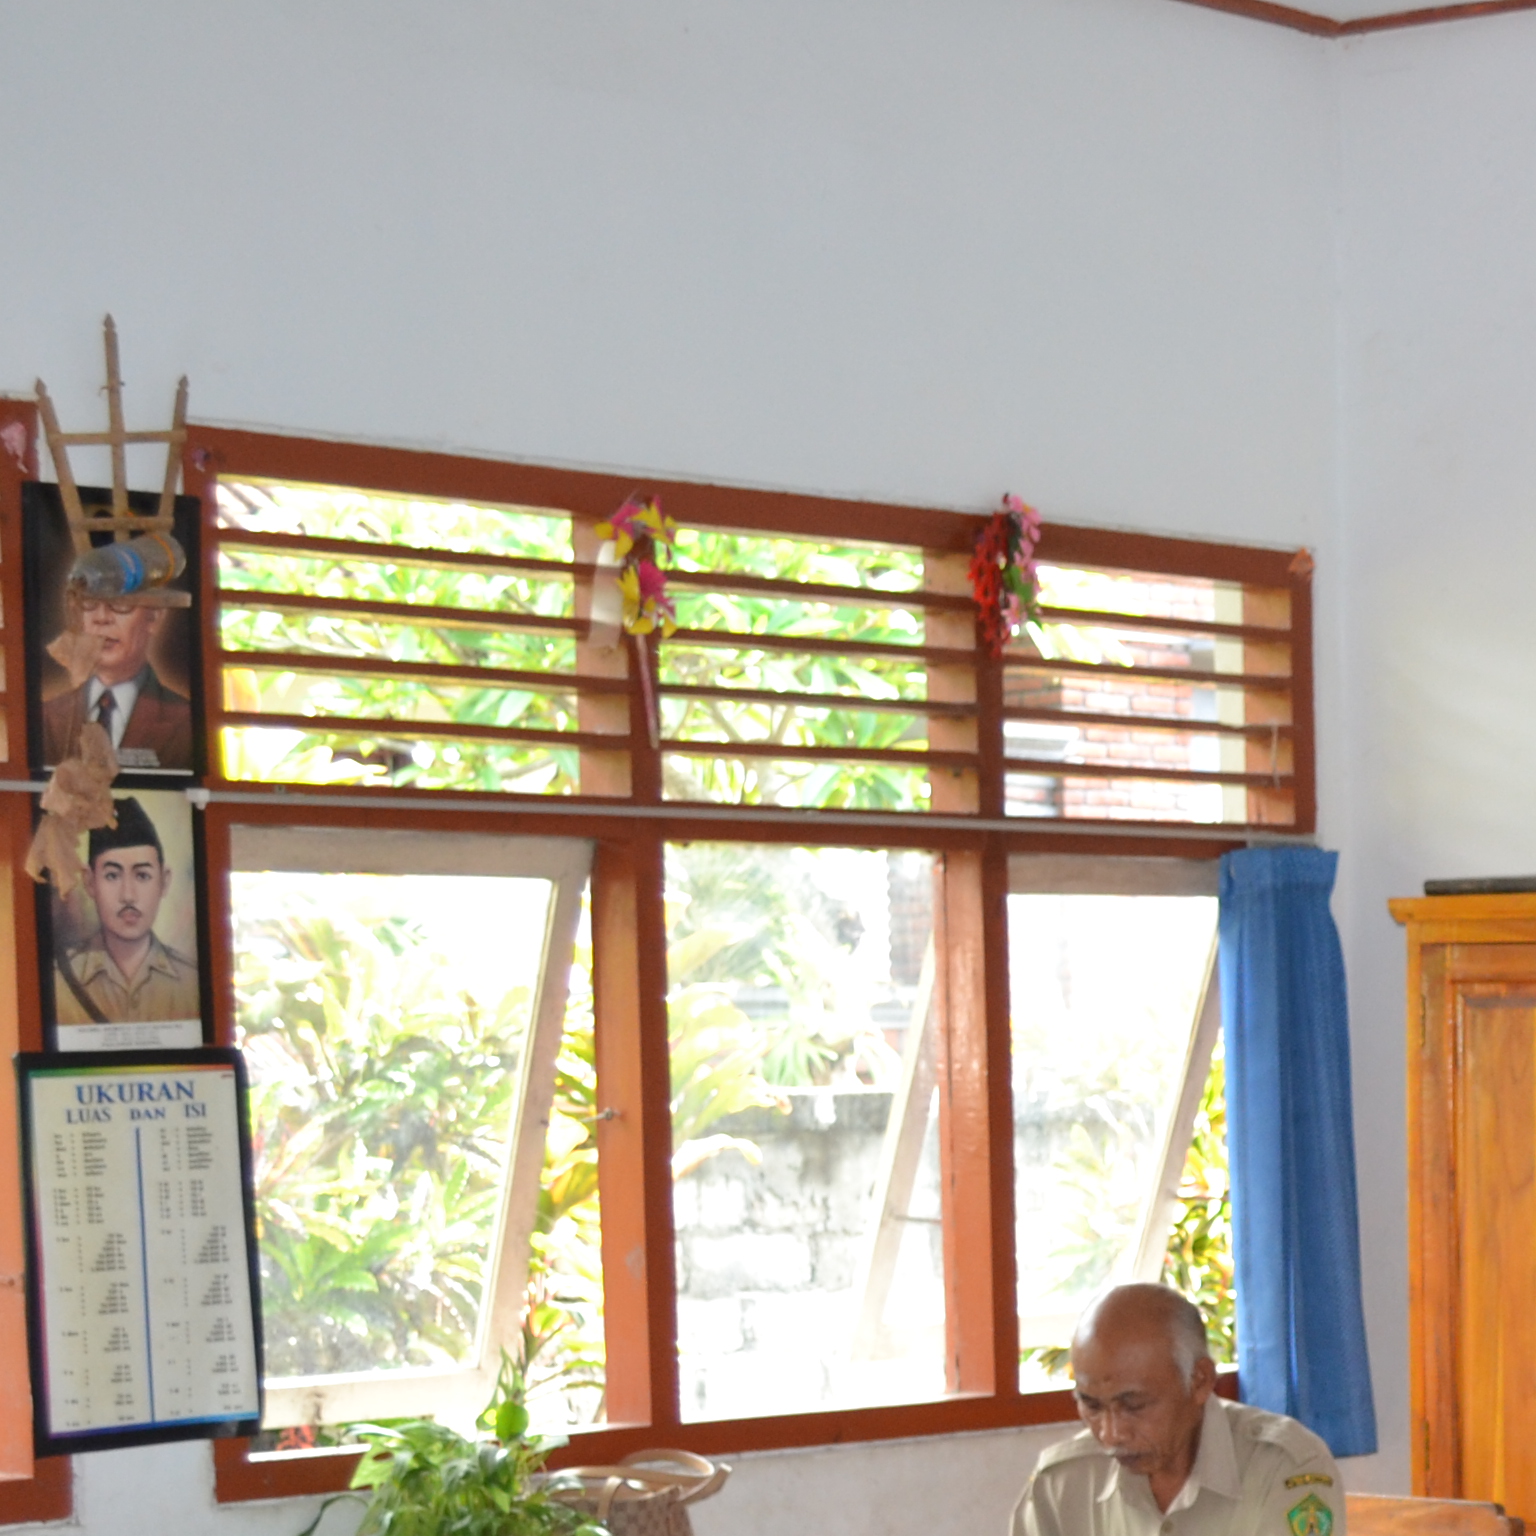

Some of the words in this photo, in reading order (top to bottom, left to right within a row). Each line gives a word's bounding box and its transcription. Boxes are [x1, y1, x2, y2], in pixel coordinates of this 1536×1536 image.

[75, 1080, 195, 1105] UKURAN
[65, 1107, 112, 1124] LUAS
[129, 1107, 166, 1120] DAN
[184, 1102, 206, 1118] ISI
